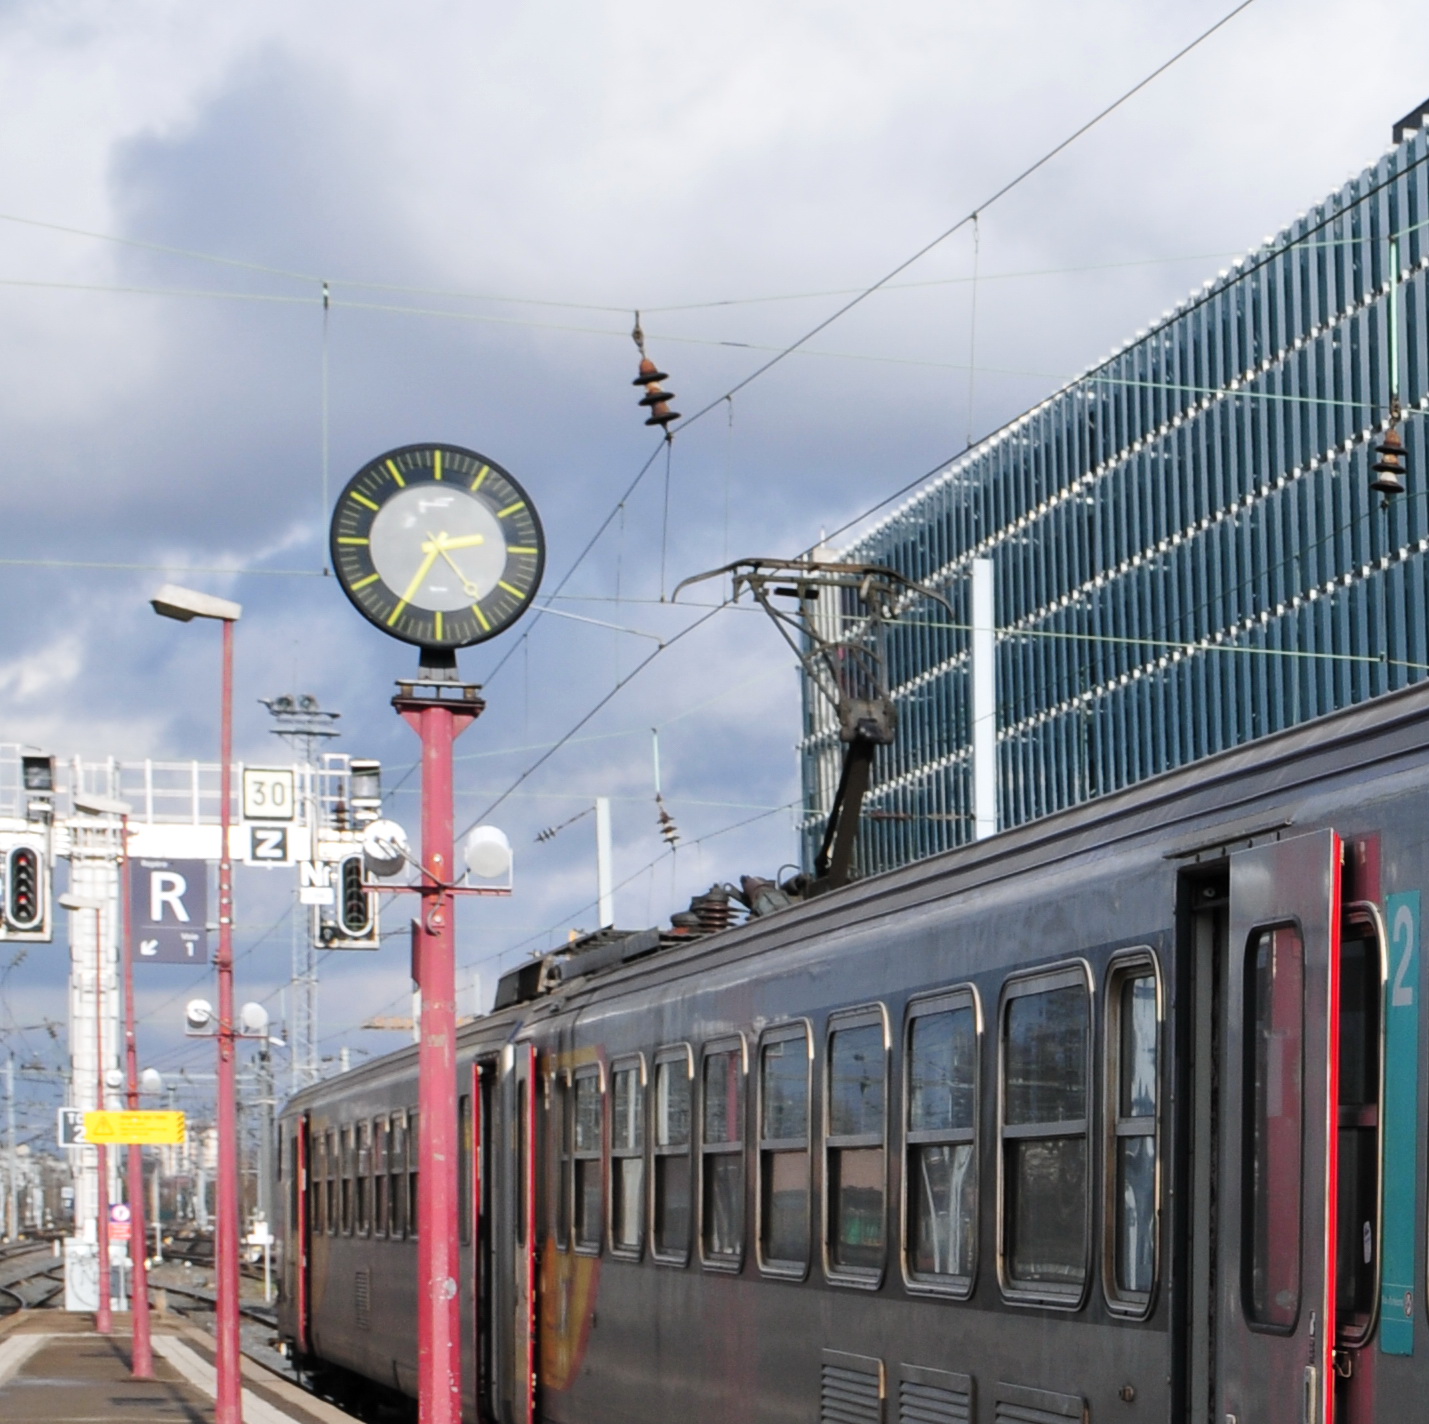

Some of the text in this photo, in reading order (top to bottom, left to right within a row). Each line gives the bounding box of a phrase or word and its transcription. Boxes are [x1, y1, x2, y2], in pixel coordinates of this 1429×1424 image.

[253, 781, 285, 806] 30
[255, 830, 284, 859] Z
[151, 871, 190, 922] R
[186, 942, 195, 957] 1
[1392, 905, 1414, 1006] 2
